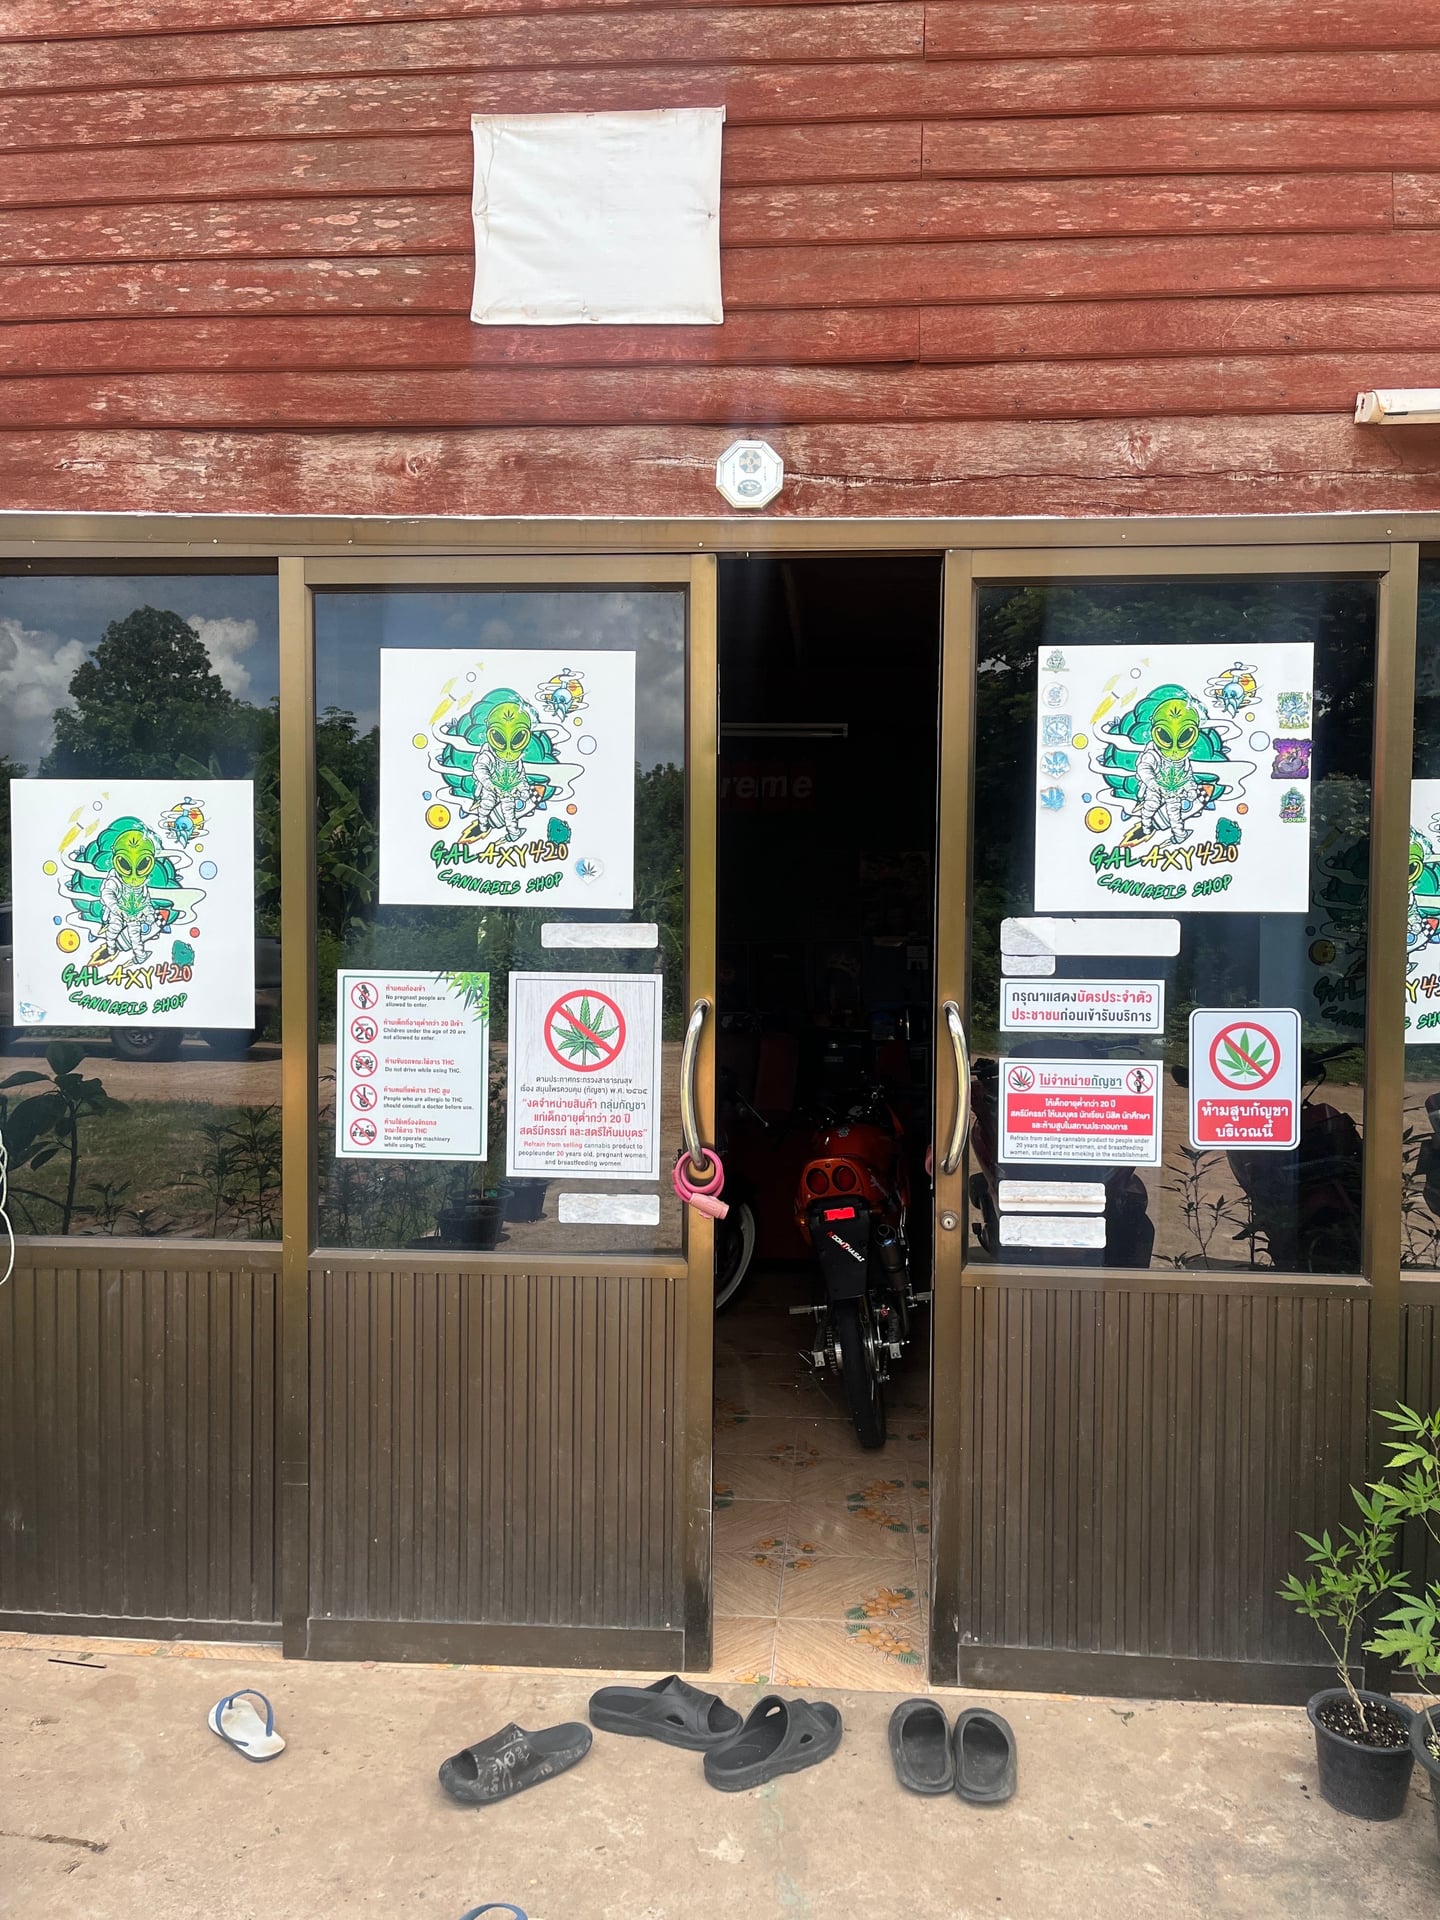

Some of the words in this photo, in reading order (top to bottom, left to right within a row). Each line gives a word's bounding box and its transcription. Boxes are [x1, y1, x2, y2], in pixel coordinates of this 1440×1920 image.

[438, 868, 521, 895] CANNABIS
[526, 872, 563, 894] SHOP
[1097, 873, 1186, 900] CANNABIS
[1192, 874, 1232, 897] SHOP
[68, 991, 147, 1016] CANNABIS
[152, 993, 188, 1015] SHOP
[1012, 989, 1152, 1006] กรุณาแสดงบัตรประจำตัว
[1011, 1007, 1152, 1022] ประชาชนก่อนเข้ารับบริการ
[1039, 1073, 1122, 1089] ไม่จำหน่ายกัญชา
[600, 1099, 646, 1112] กลุ่มกัญชา
[1111, 1099, 1116, 1108] ปี
[1201, 1100, 1288, 1122] ห้ามสูบกัญชา
[534, 1110, 607, 1125] แก่เด็กอายุต่ำกว่า
[610, 1114, 621, 1123] 20
[624, 1113, 631, 1123] ปี
[519, 1125, 567, 1137] สตรีมีครรภ์
[1215, 1118, 1274, 1137] บริเวณนี้
